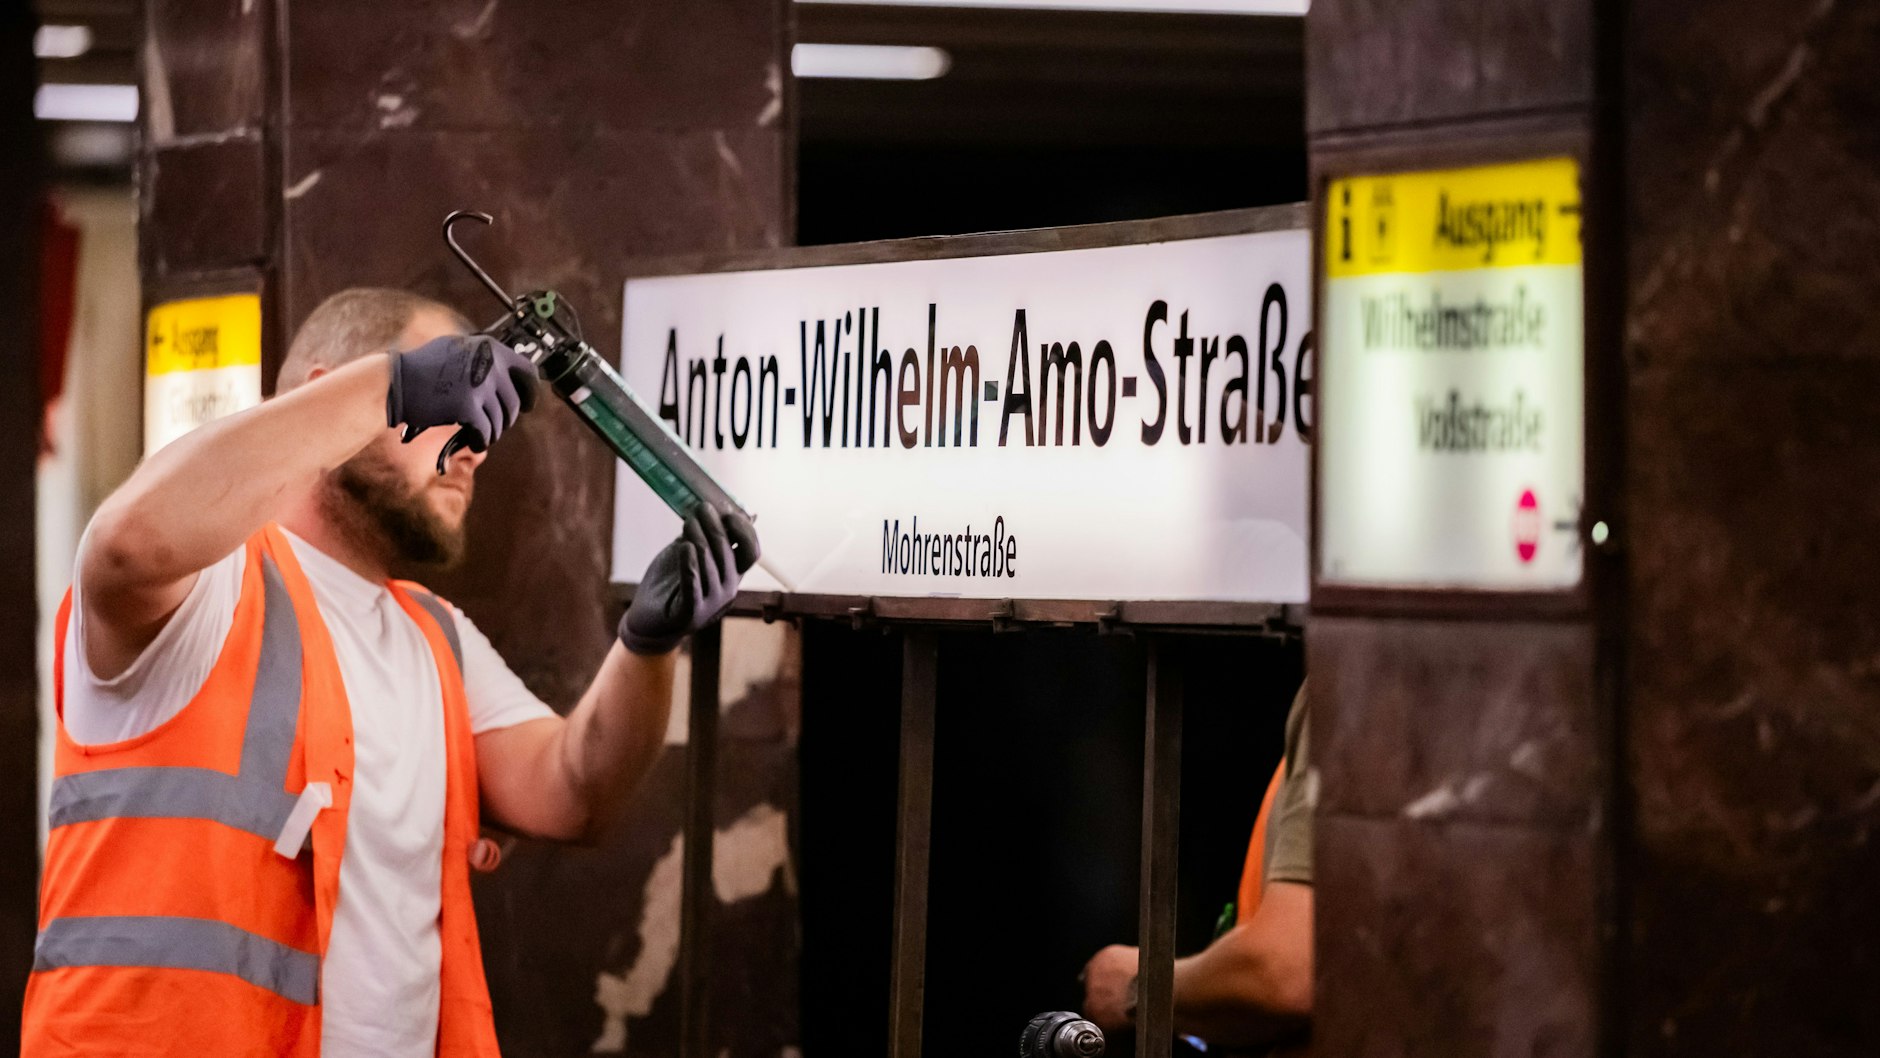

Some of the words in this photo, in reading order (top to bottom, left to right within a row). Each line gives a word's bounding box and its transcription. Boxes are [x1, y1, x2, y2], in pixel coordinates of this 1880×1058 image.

[1434, 189, 1546, 259] Ausgang
[1362, 284, 1545, 350] Wilhelmstraße
[658, 282, 1313, 449] Anton-Wilhelm-Amo-Straße
[1417, 389, 1544, 452] Voßstraße
[882, 515, 1016, 578] Mohrenstraße
